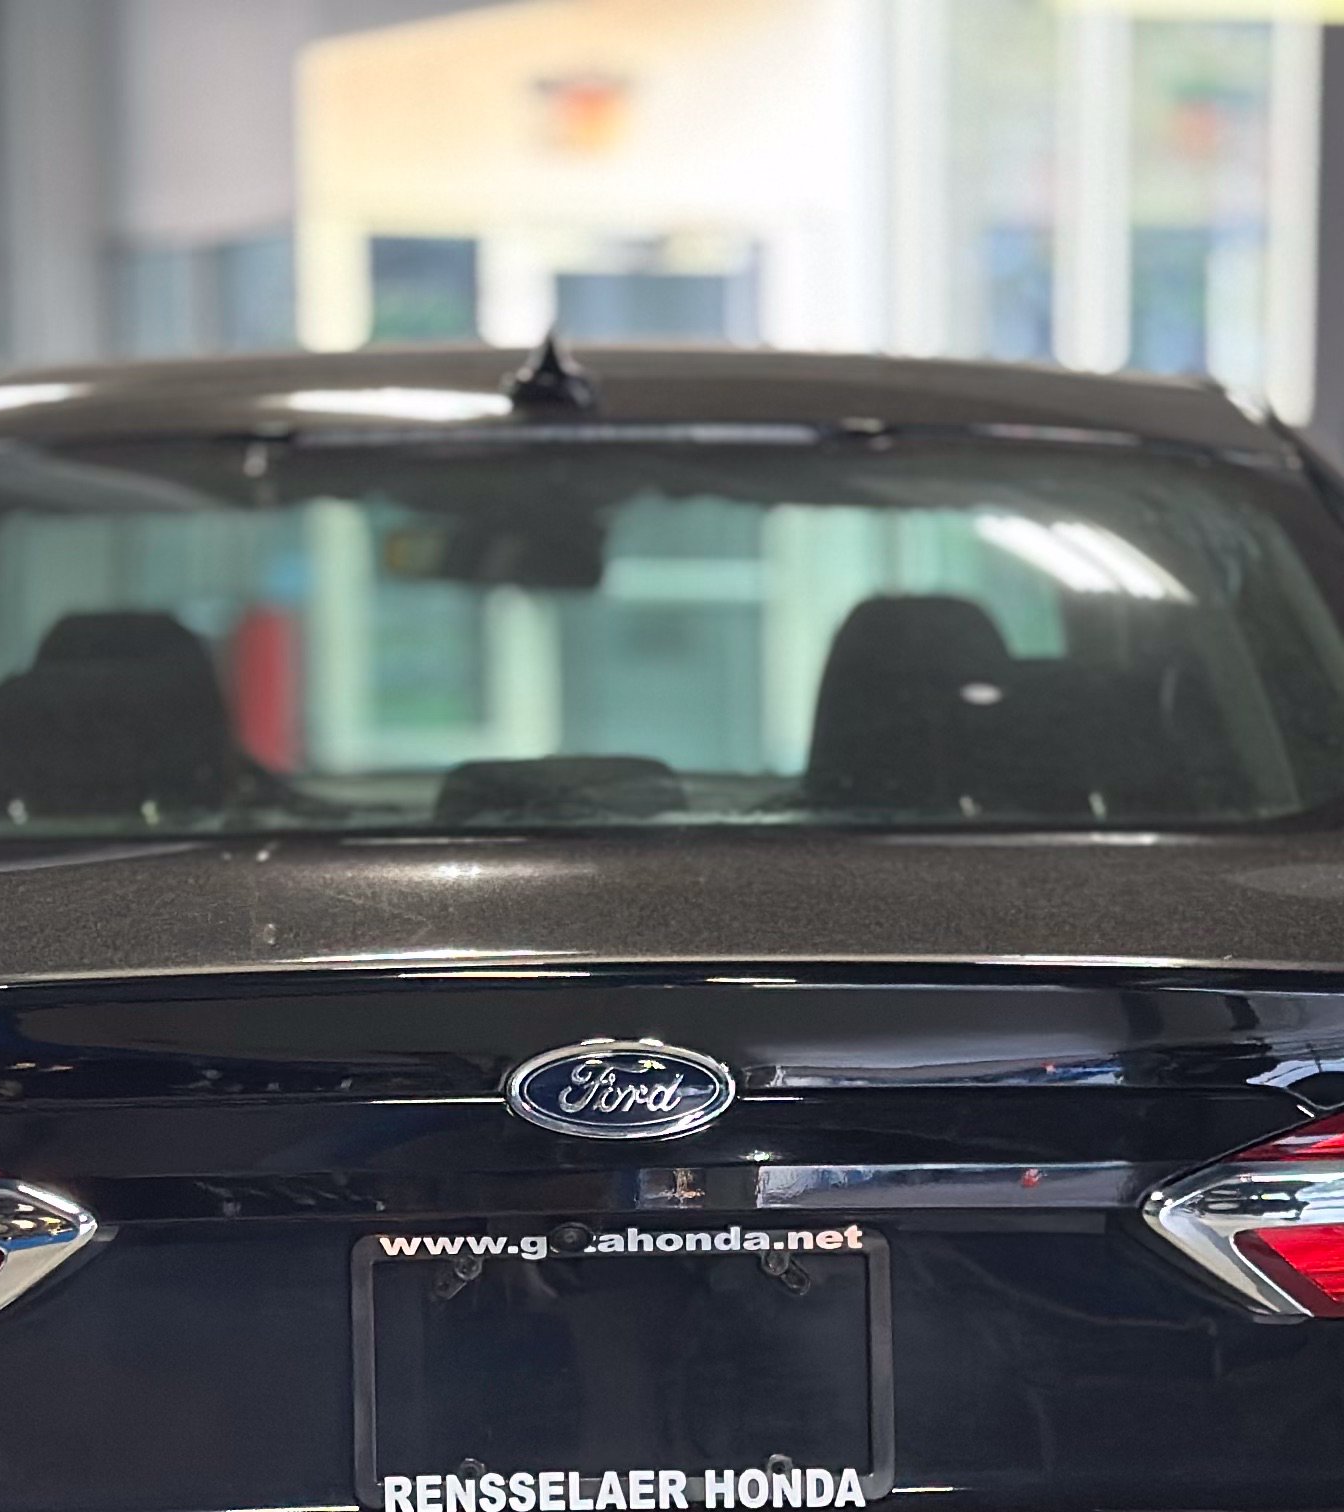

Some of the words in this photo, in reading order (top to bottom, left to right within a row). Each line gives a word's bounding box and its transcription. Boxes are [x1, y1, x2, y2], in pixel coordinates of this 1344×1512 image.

[560, 1059, 685, 1113] Ford
[379, 1225, 864, 1260] www.gahonda.net
[704, 1468, 866, 1509] HONDA
